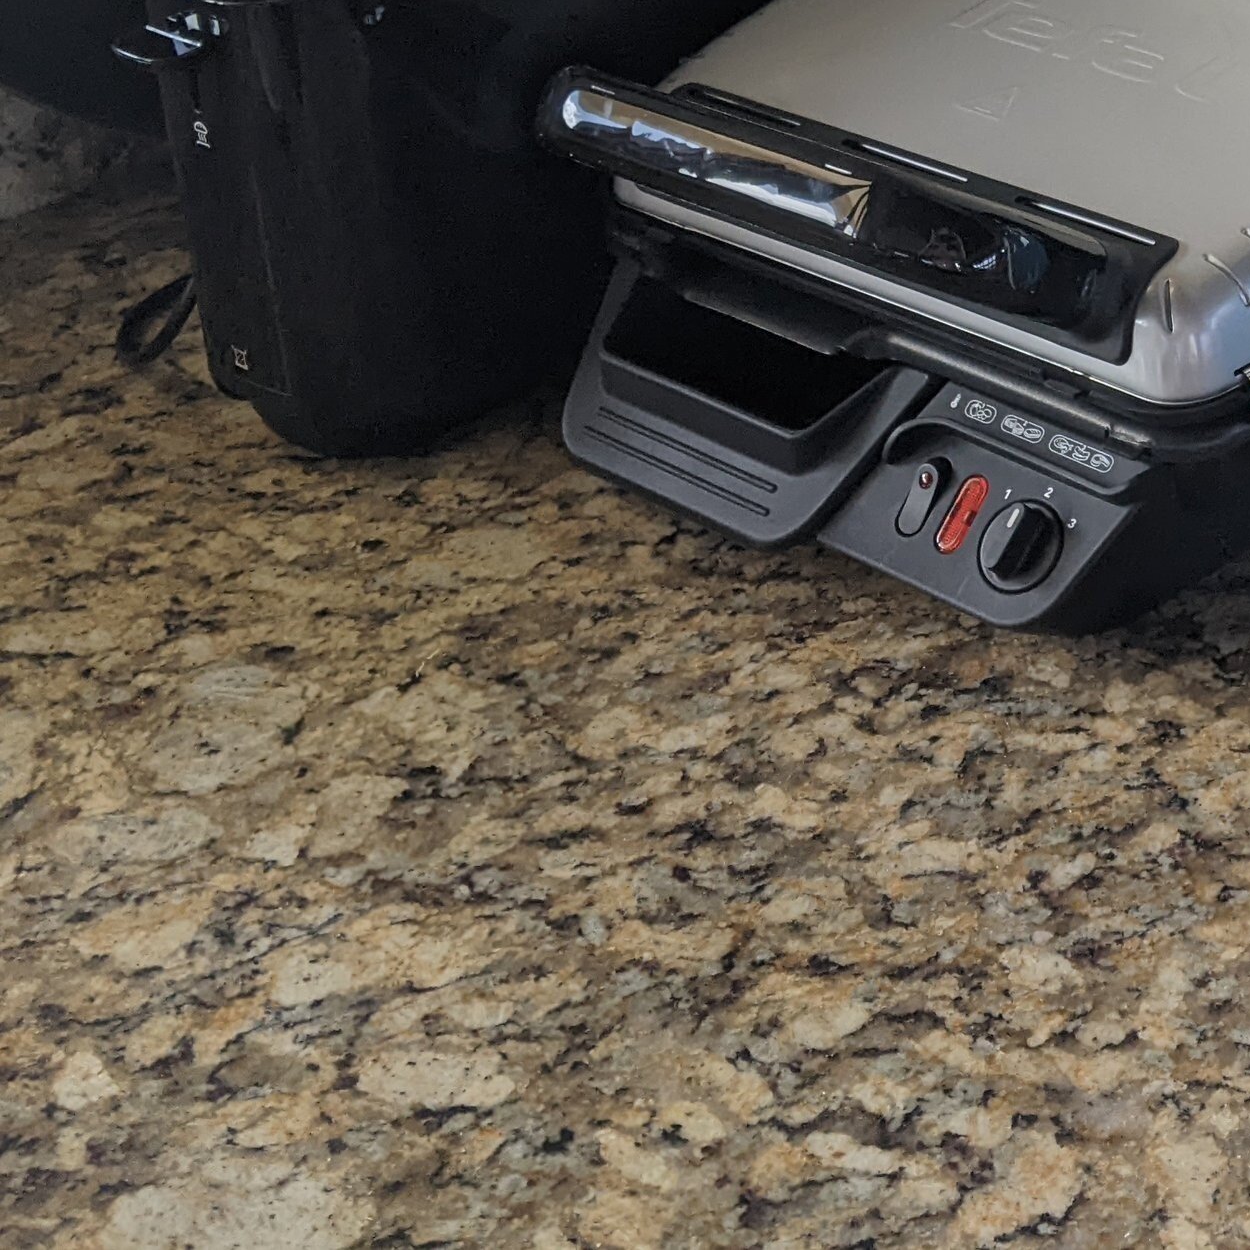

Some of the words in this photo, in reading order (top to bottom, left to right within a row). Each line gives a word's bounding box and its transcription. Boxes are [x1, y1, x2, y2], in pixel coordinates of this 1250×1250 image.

[1004, 488, 1013, 500] 1
[1044, 487, 1054, 499] 2
[1067, 517, 1078, 529] 3
